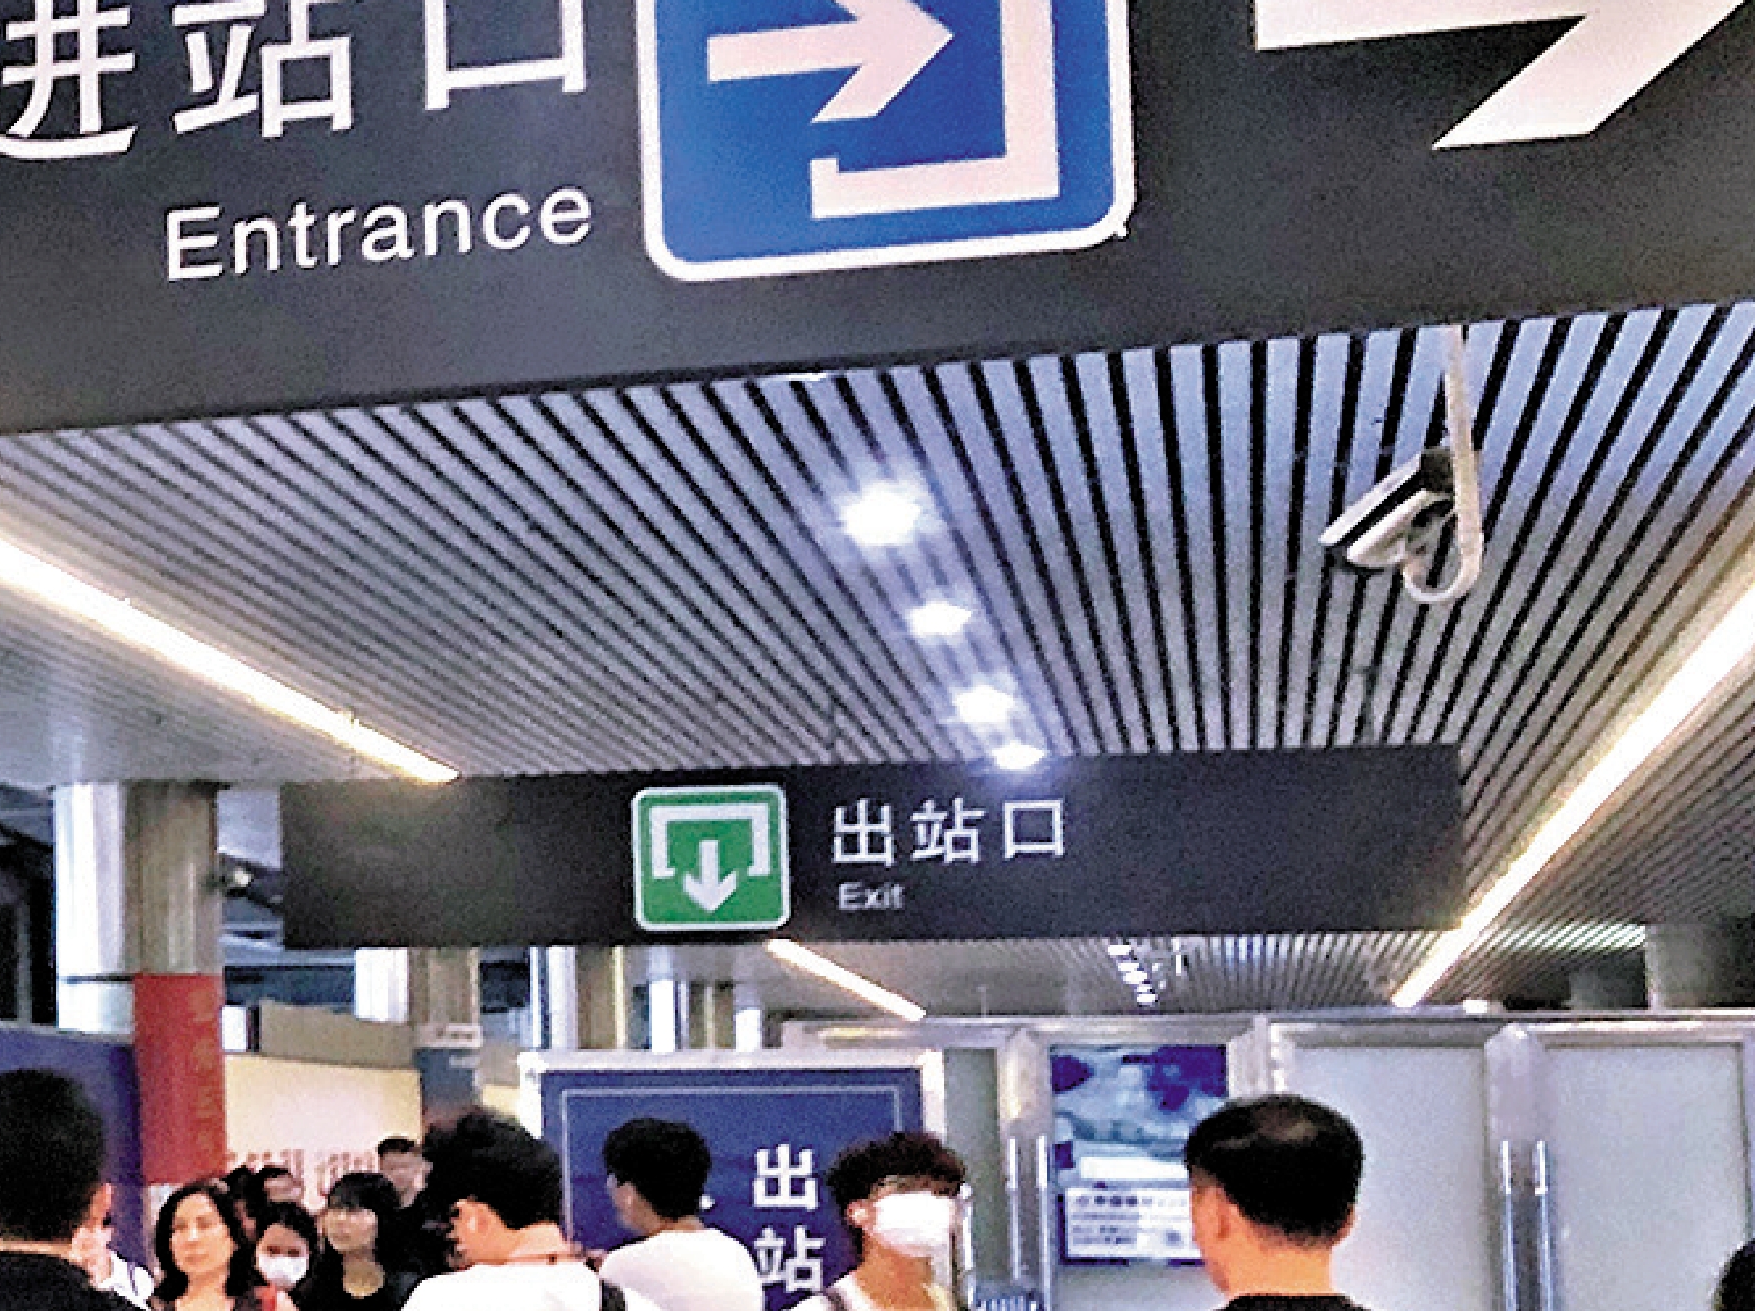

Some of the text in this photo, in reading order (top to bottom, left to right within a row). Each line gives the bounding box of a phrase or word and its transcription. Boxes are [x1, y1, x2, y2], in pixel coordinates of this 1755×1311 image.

[166, 186, 593, 282] Entrance
[833, 797, 1065, 867] 出站口
[839, 881, 905, 911] Exit
